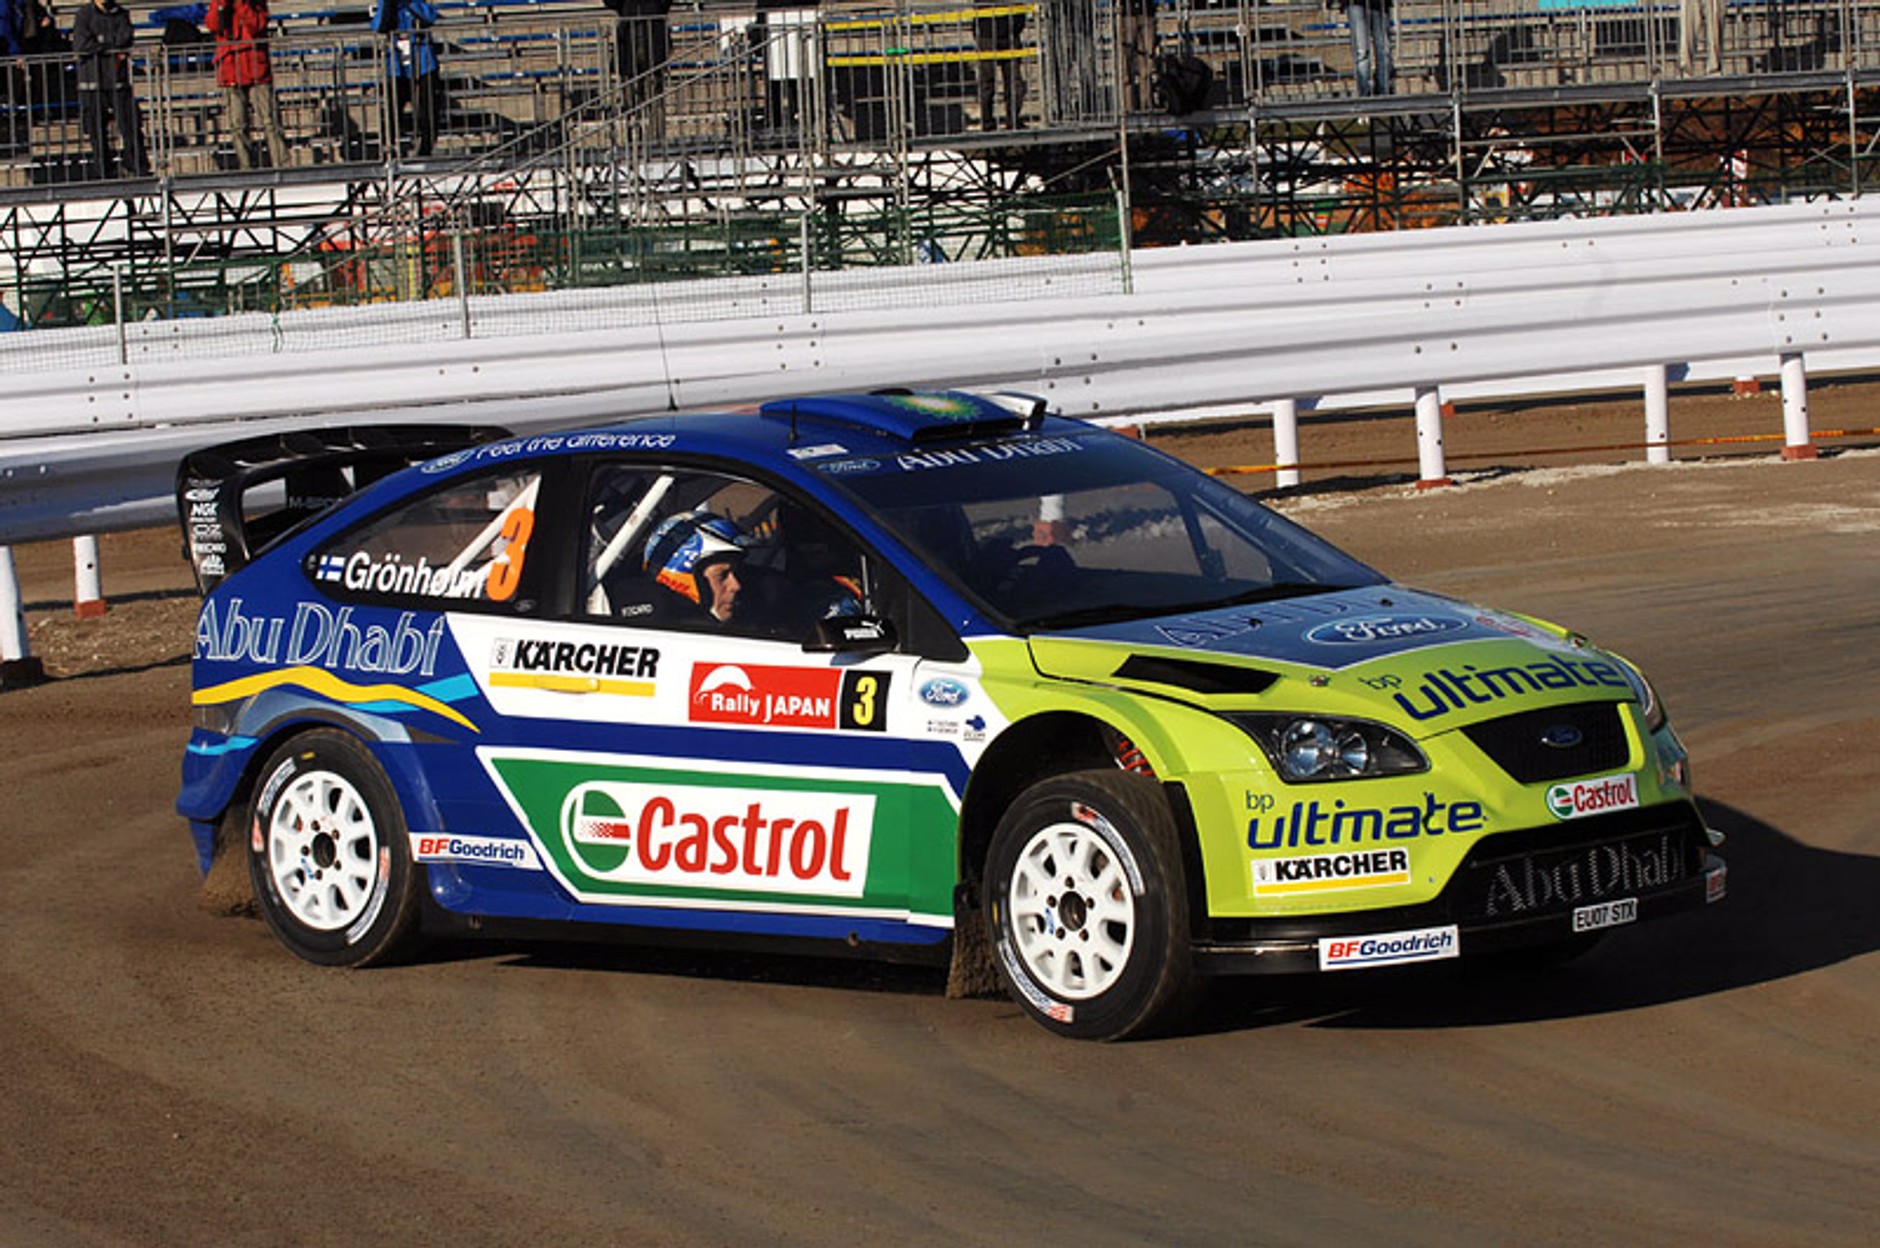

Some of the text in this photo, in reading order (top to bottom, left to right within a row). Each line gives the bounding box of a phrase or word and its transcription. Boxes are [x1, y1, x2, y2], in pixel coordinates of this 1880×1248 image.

[486, 507, 535, 602] 3
[193, 597, 447, 676] Abu Dhabi
[1333, 616, 1446, 643] Ford
[513, 640, 661, 678] KÄRCHER
[1358, 671, 1402, 692] bp
[1392, 655, 1628, 722] ultimate
[710, 693, 831, 722] Rally JAPAN
[852, 676, 878, 726] 3
[1245, 790, 1275, 813] bp
[1573, 777, 1636, 812] Castrol
[1248, 792, 1484, 849] ultimate
[419, 838, 525, 860] BFGoodrich
[636, 796, 852, 881] Castrol
[1275, 851, 1407, 881] KÄRCHER
[1486, 857, 1582, 918] Abu
[1576, 900, 1636, 931] EU07 STX
[1327, 932, 1452, 959] BFGoodrich
